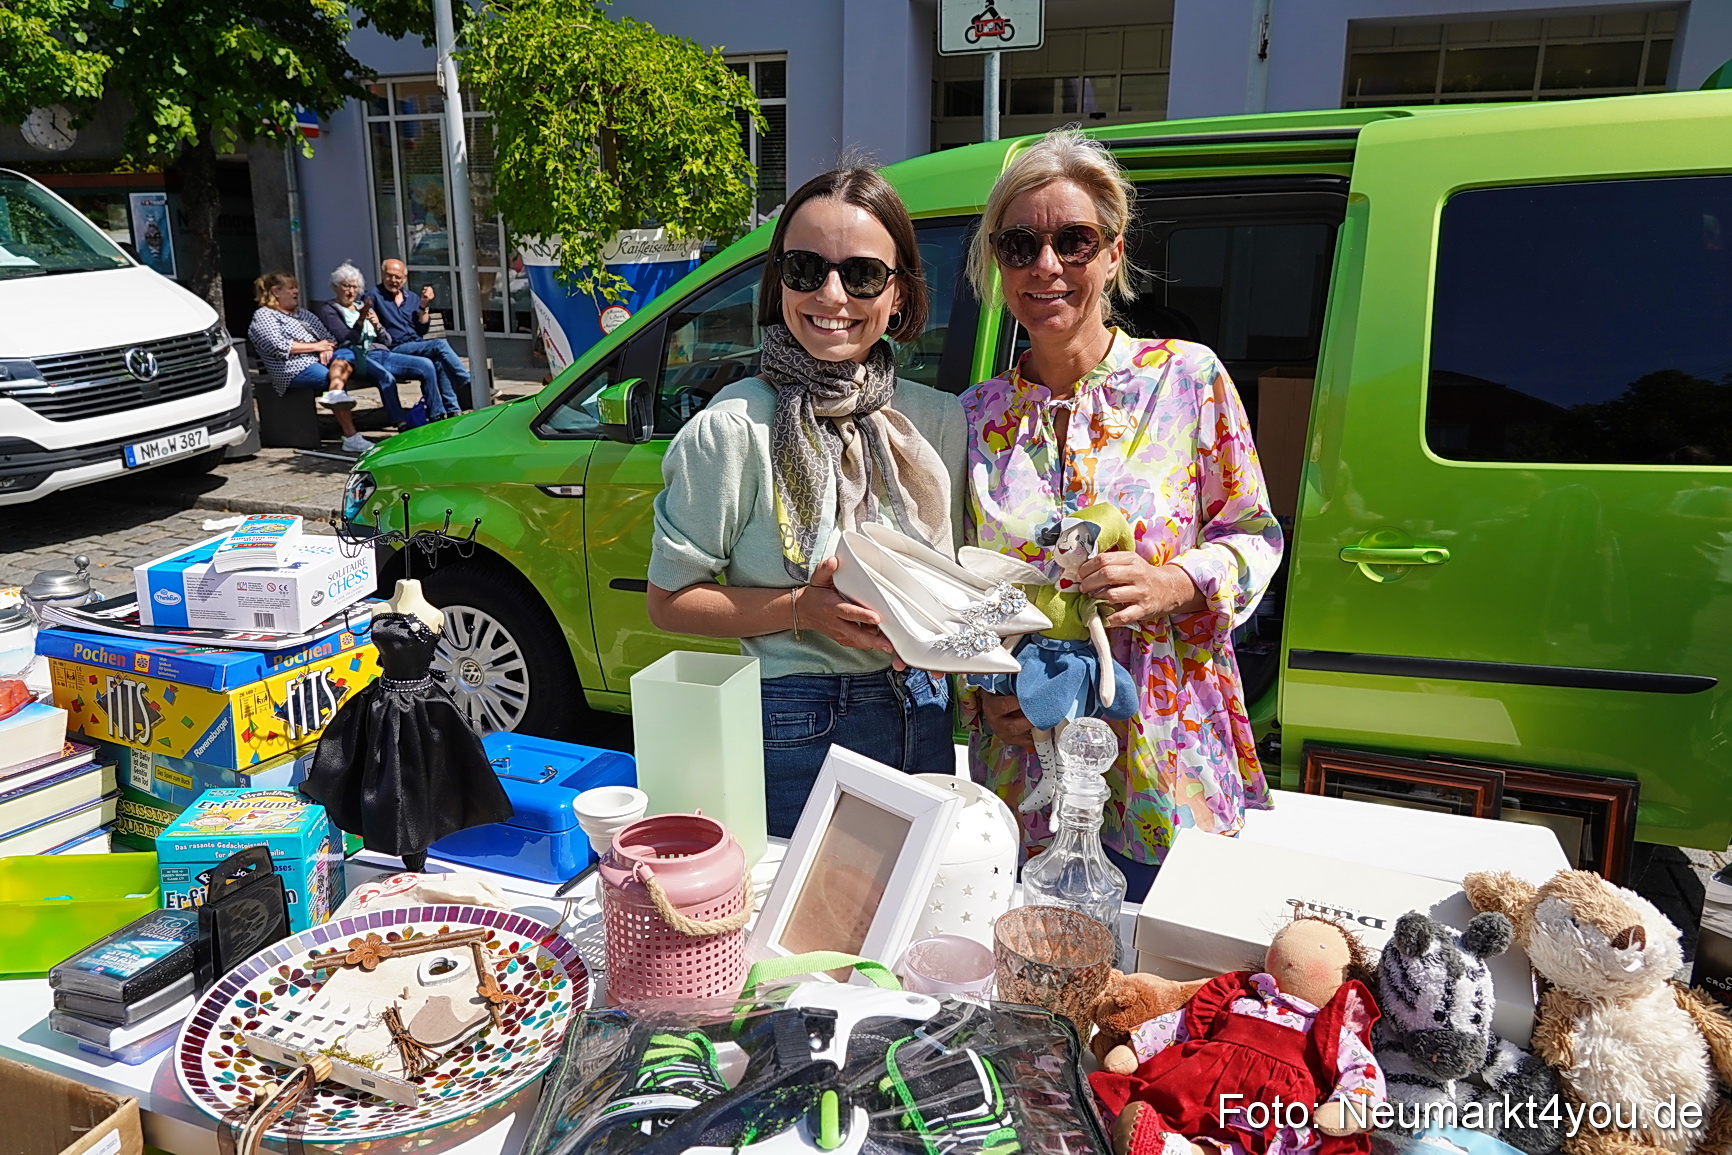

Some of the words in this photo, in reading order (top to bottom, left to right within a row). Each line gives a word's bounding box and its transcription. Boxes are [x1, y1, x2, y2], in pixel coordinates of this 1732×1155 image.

[140, 442, 160, 460] NM
[167, 437, 177, 453] W
[180, 431, 202, 449] 387
[327, 557, 367, 583] SOLITAIRE
[73, 643, 126, 667] Pochen
[273, 642, 333, 671] Pochen
[193, 716, 229, 758] Ravensburger
[140, 752, 150, 762] Dativ
[134, 766, 148, 777] Genitiv
[181, 778, 190, 786] Buch
[1286, 898, 1387, 931] Dune
[100, 954, 133, 964] WARS
[106, 950, 141, 960] STAR
